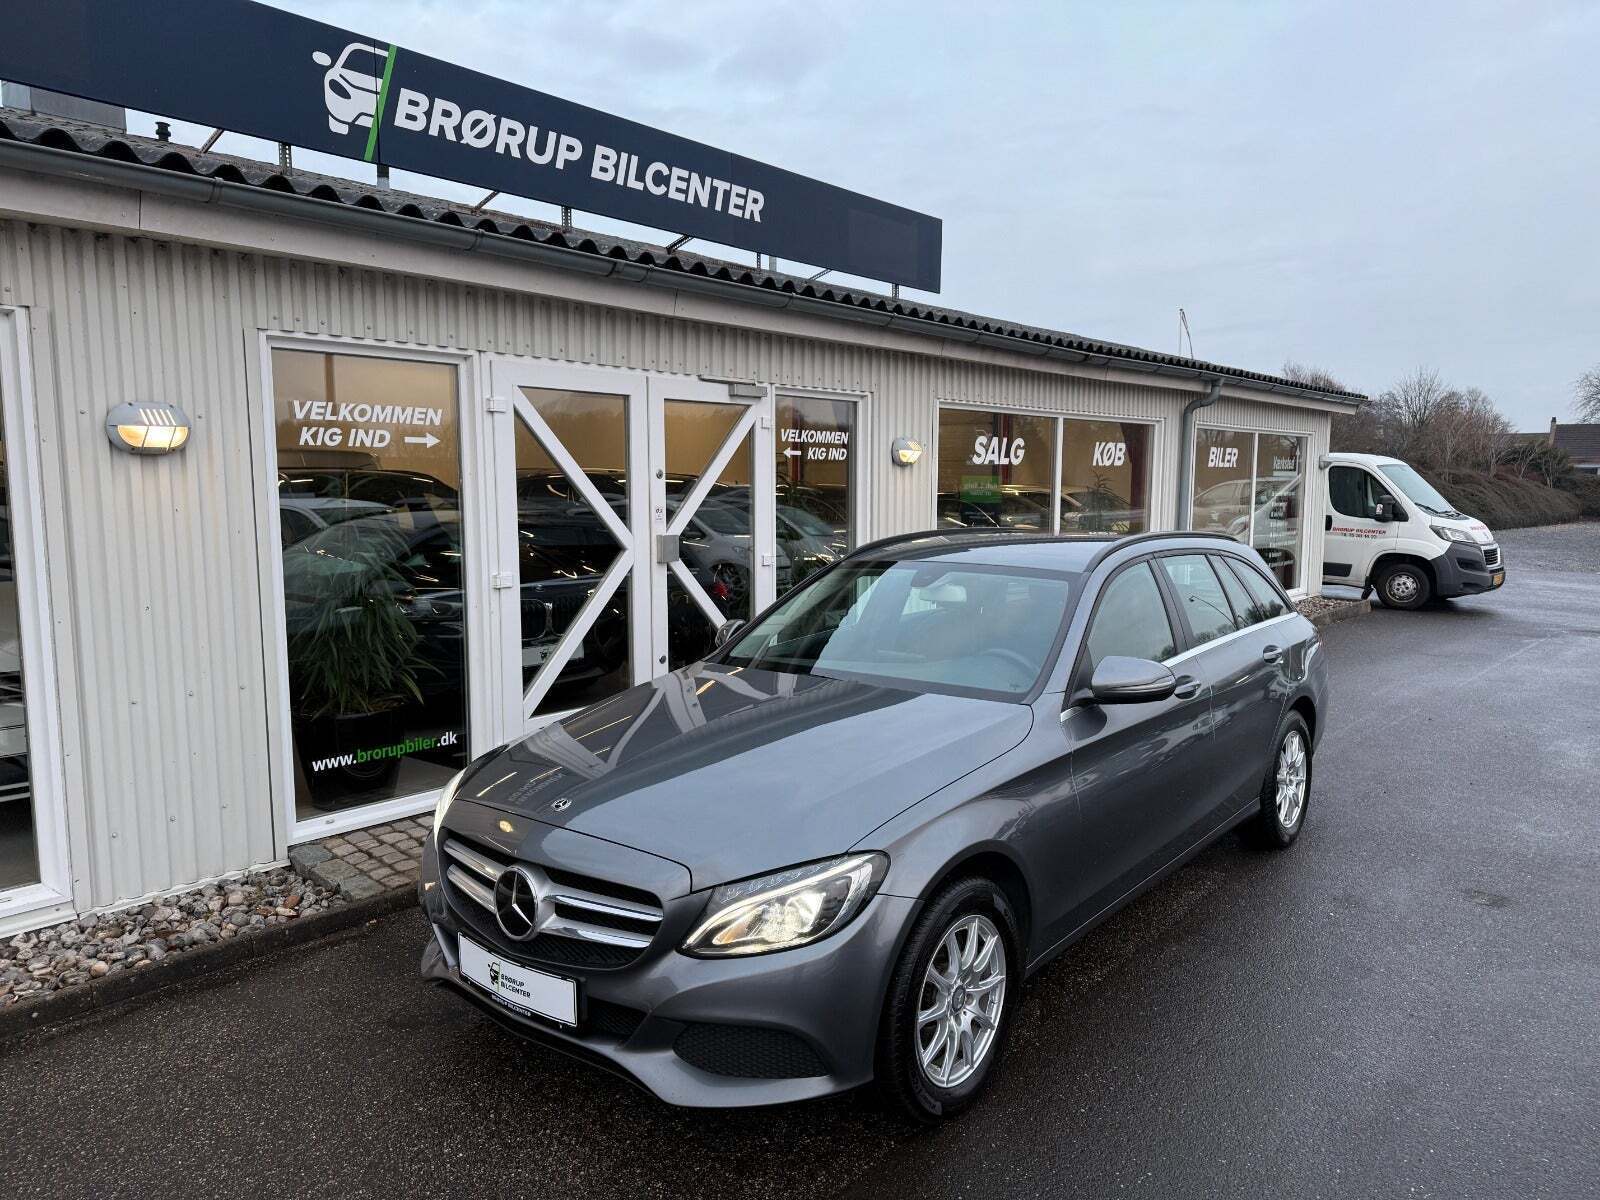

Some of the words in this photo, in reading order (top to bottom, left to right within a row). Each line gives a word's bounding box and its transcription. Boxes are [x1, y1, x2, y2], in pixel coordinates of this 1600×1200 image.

[393, 87, 583, 170] BRØRUP
[591, 144, 765, 223] BILCENTER
[292, 400, 443, 426] VELKOMMEN
[299, 427, 343, 447] KIG
[347, 428, 391, 448] IND
[781, 429, 849, 444] VELKOMMEN
[807, 447, 827, 460] KIG
[828, 448, 848, 461] IND
[972, 435, 1026, 466] SALG
[1092, 441, 1127, 467] KØB
[1208, 447, 1239, 468] BILER
[312, 731, 458, 772] www.brorupbiler.dk
